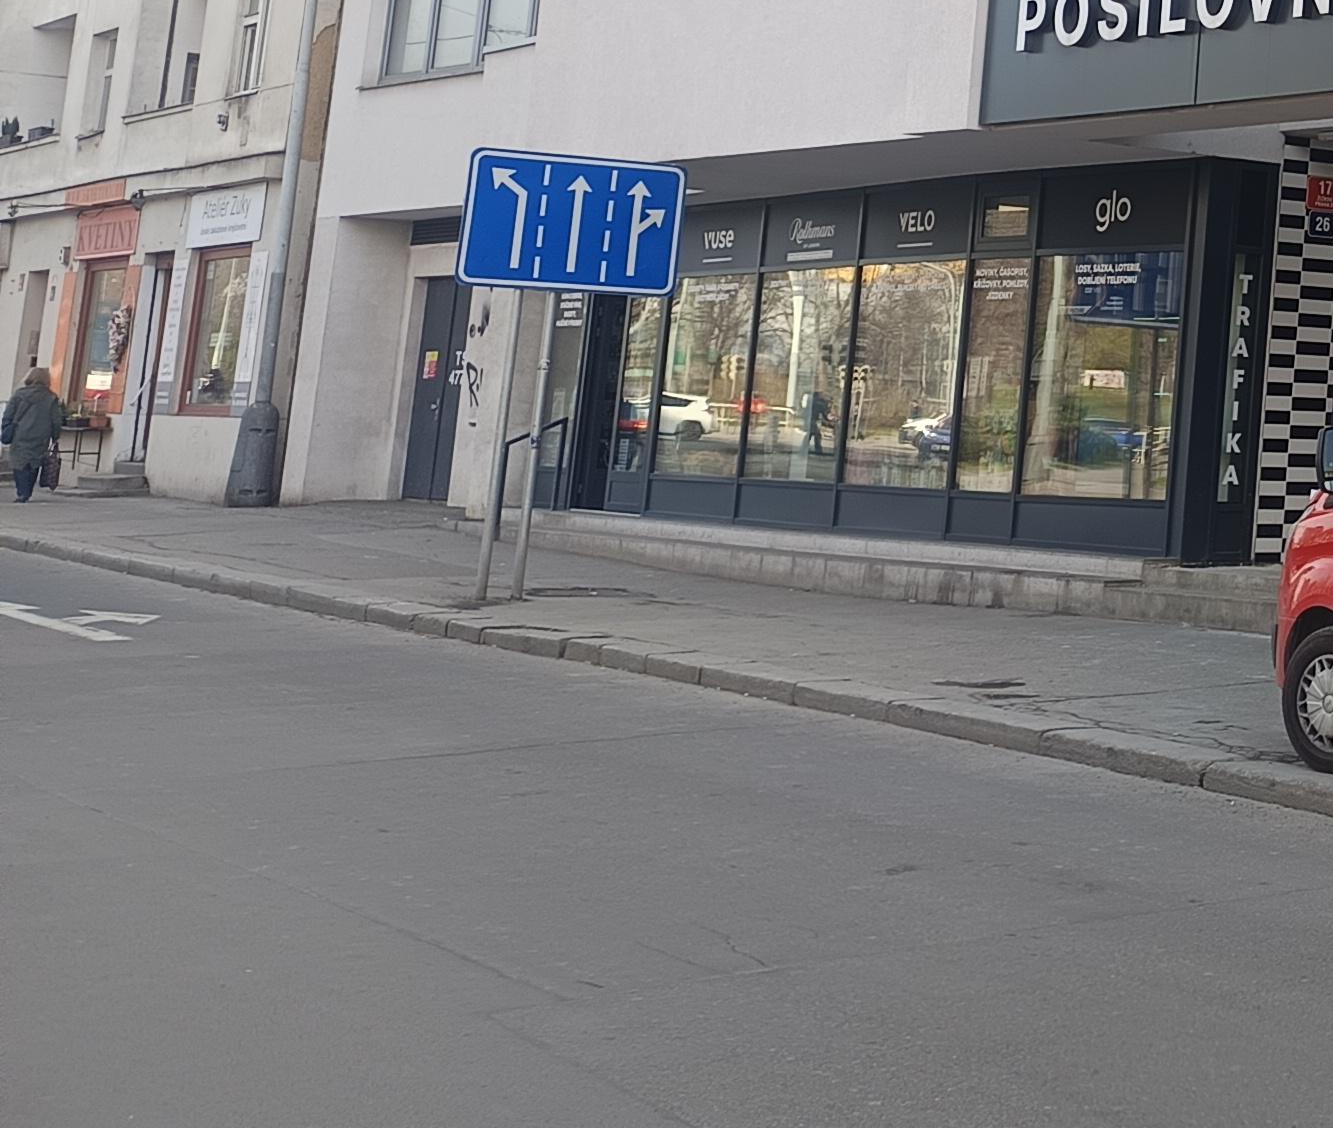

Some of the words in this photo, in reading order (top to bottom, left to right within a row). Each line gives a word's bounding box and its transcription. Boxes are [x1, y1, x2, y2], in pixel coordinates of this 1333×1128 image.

[1319, 180, 1333, 196] 17
[899, 210, 935, 233] VELO
[1096, 189, 1131, 232] glo
[1315, 216, 1331, 232] 26
[1221, 273, 1253, 486] TRAFIKA
